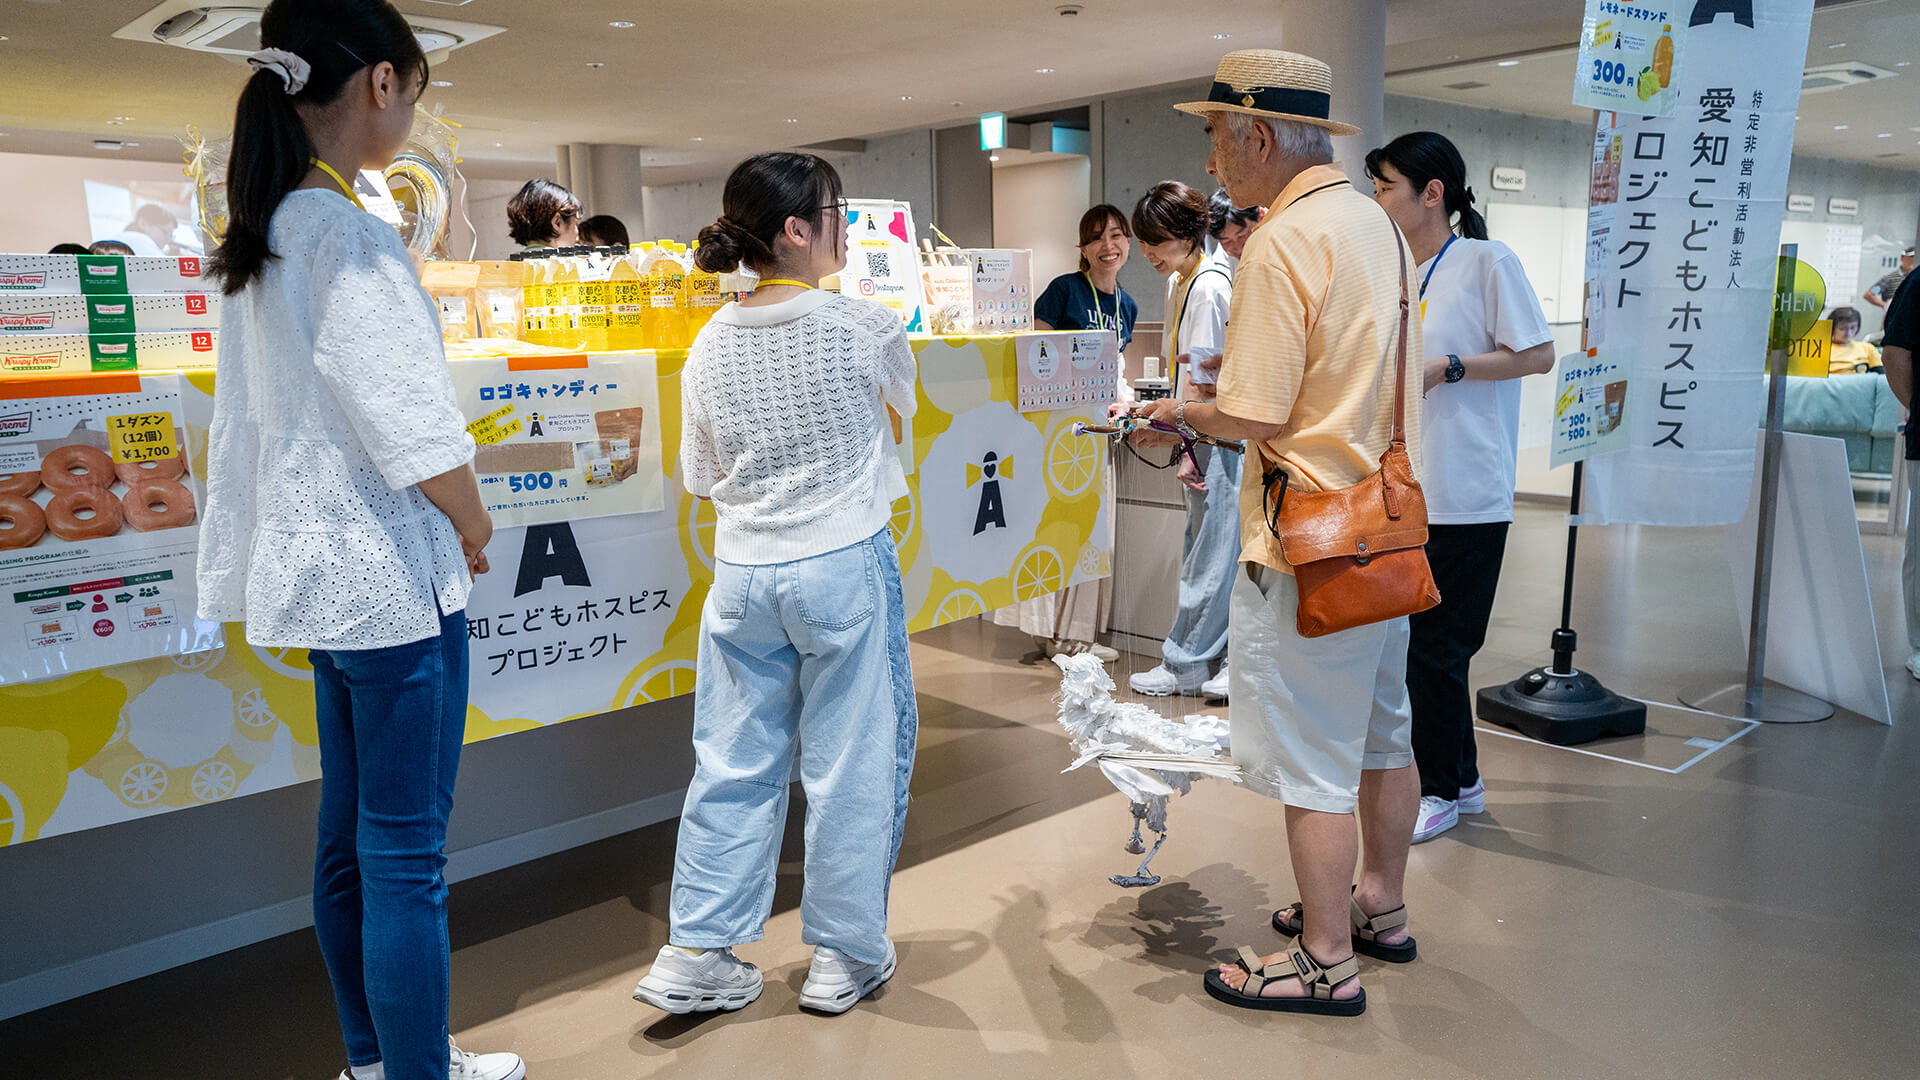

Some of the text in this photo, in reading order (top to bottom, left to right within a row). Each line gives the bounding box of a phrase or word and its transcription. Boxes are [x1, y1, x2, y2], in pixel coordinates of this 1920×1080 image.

[1600, 1, 1667, 23] レモネードスタンド
[1727, 89, 1763, 289] 特定非営利活動法人
[1617, 114, 1668, 308] ロジェクト
[184, 262, 195, 271] 12
[1653, 88, 1735, 449] 愛知こどもホスピス
[190, 299, 201, 308] 12
[25, 315, 51, 325] Kreme
[196, 337, 208, 346] 12
[5, 355, 58, 366] Krispy Kreme
[480, 380, 617, 400] ロゴキャンディー
[488, 632, 627, 676] プロジェクト
